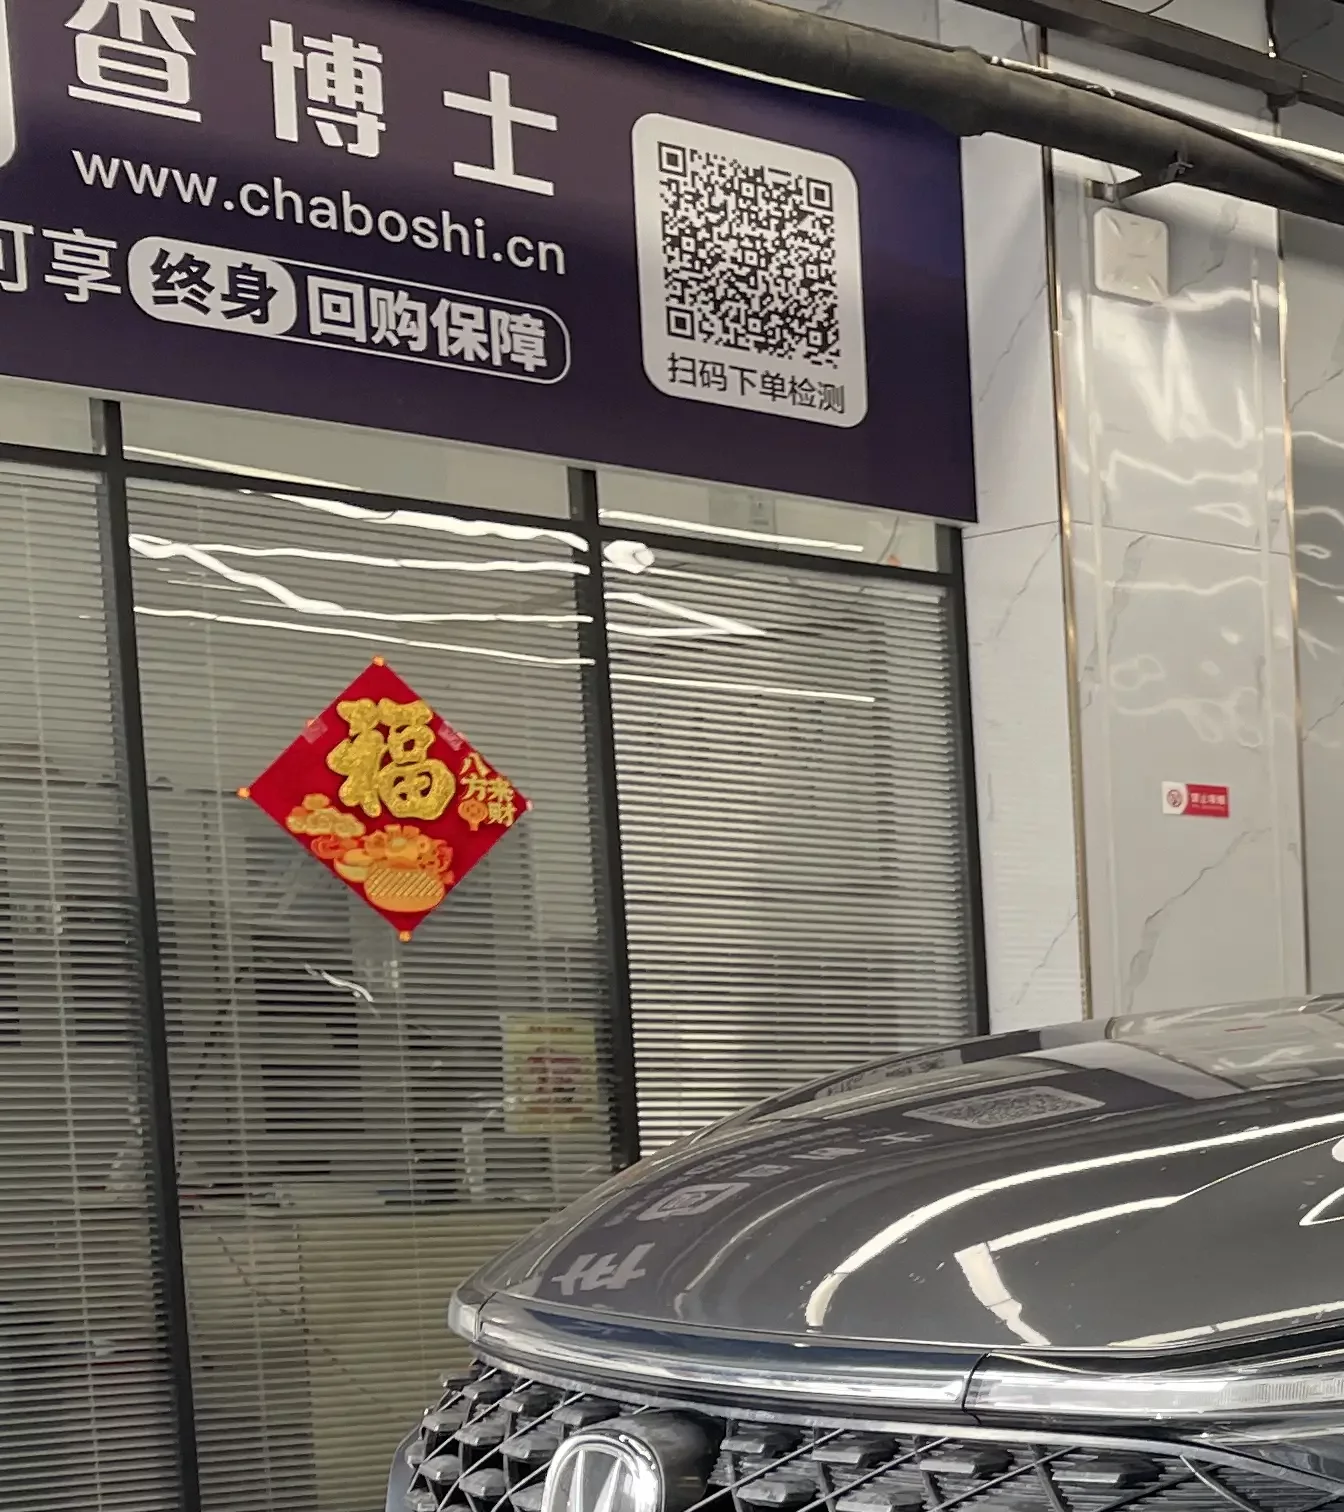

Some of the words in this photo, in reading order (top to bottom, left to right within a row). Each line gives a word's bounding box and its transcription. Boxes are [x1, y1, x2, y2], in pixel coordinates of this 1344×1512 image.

[64, 0, 558, 196] 查博士
[71, 149, 567, 276] www.chaboshi.cn
[666, 352, 846, 415] 扫码下单检测
[326, 698, 456, 820] 福
